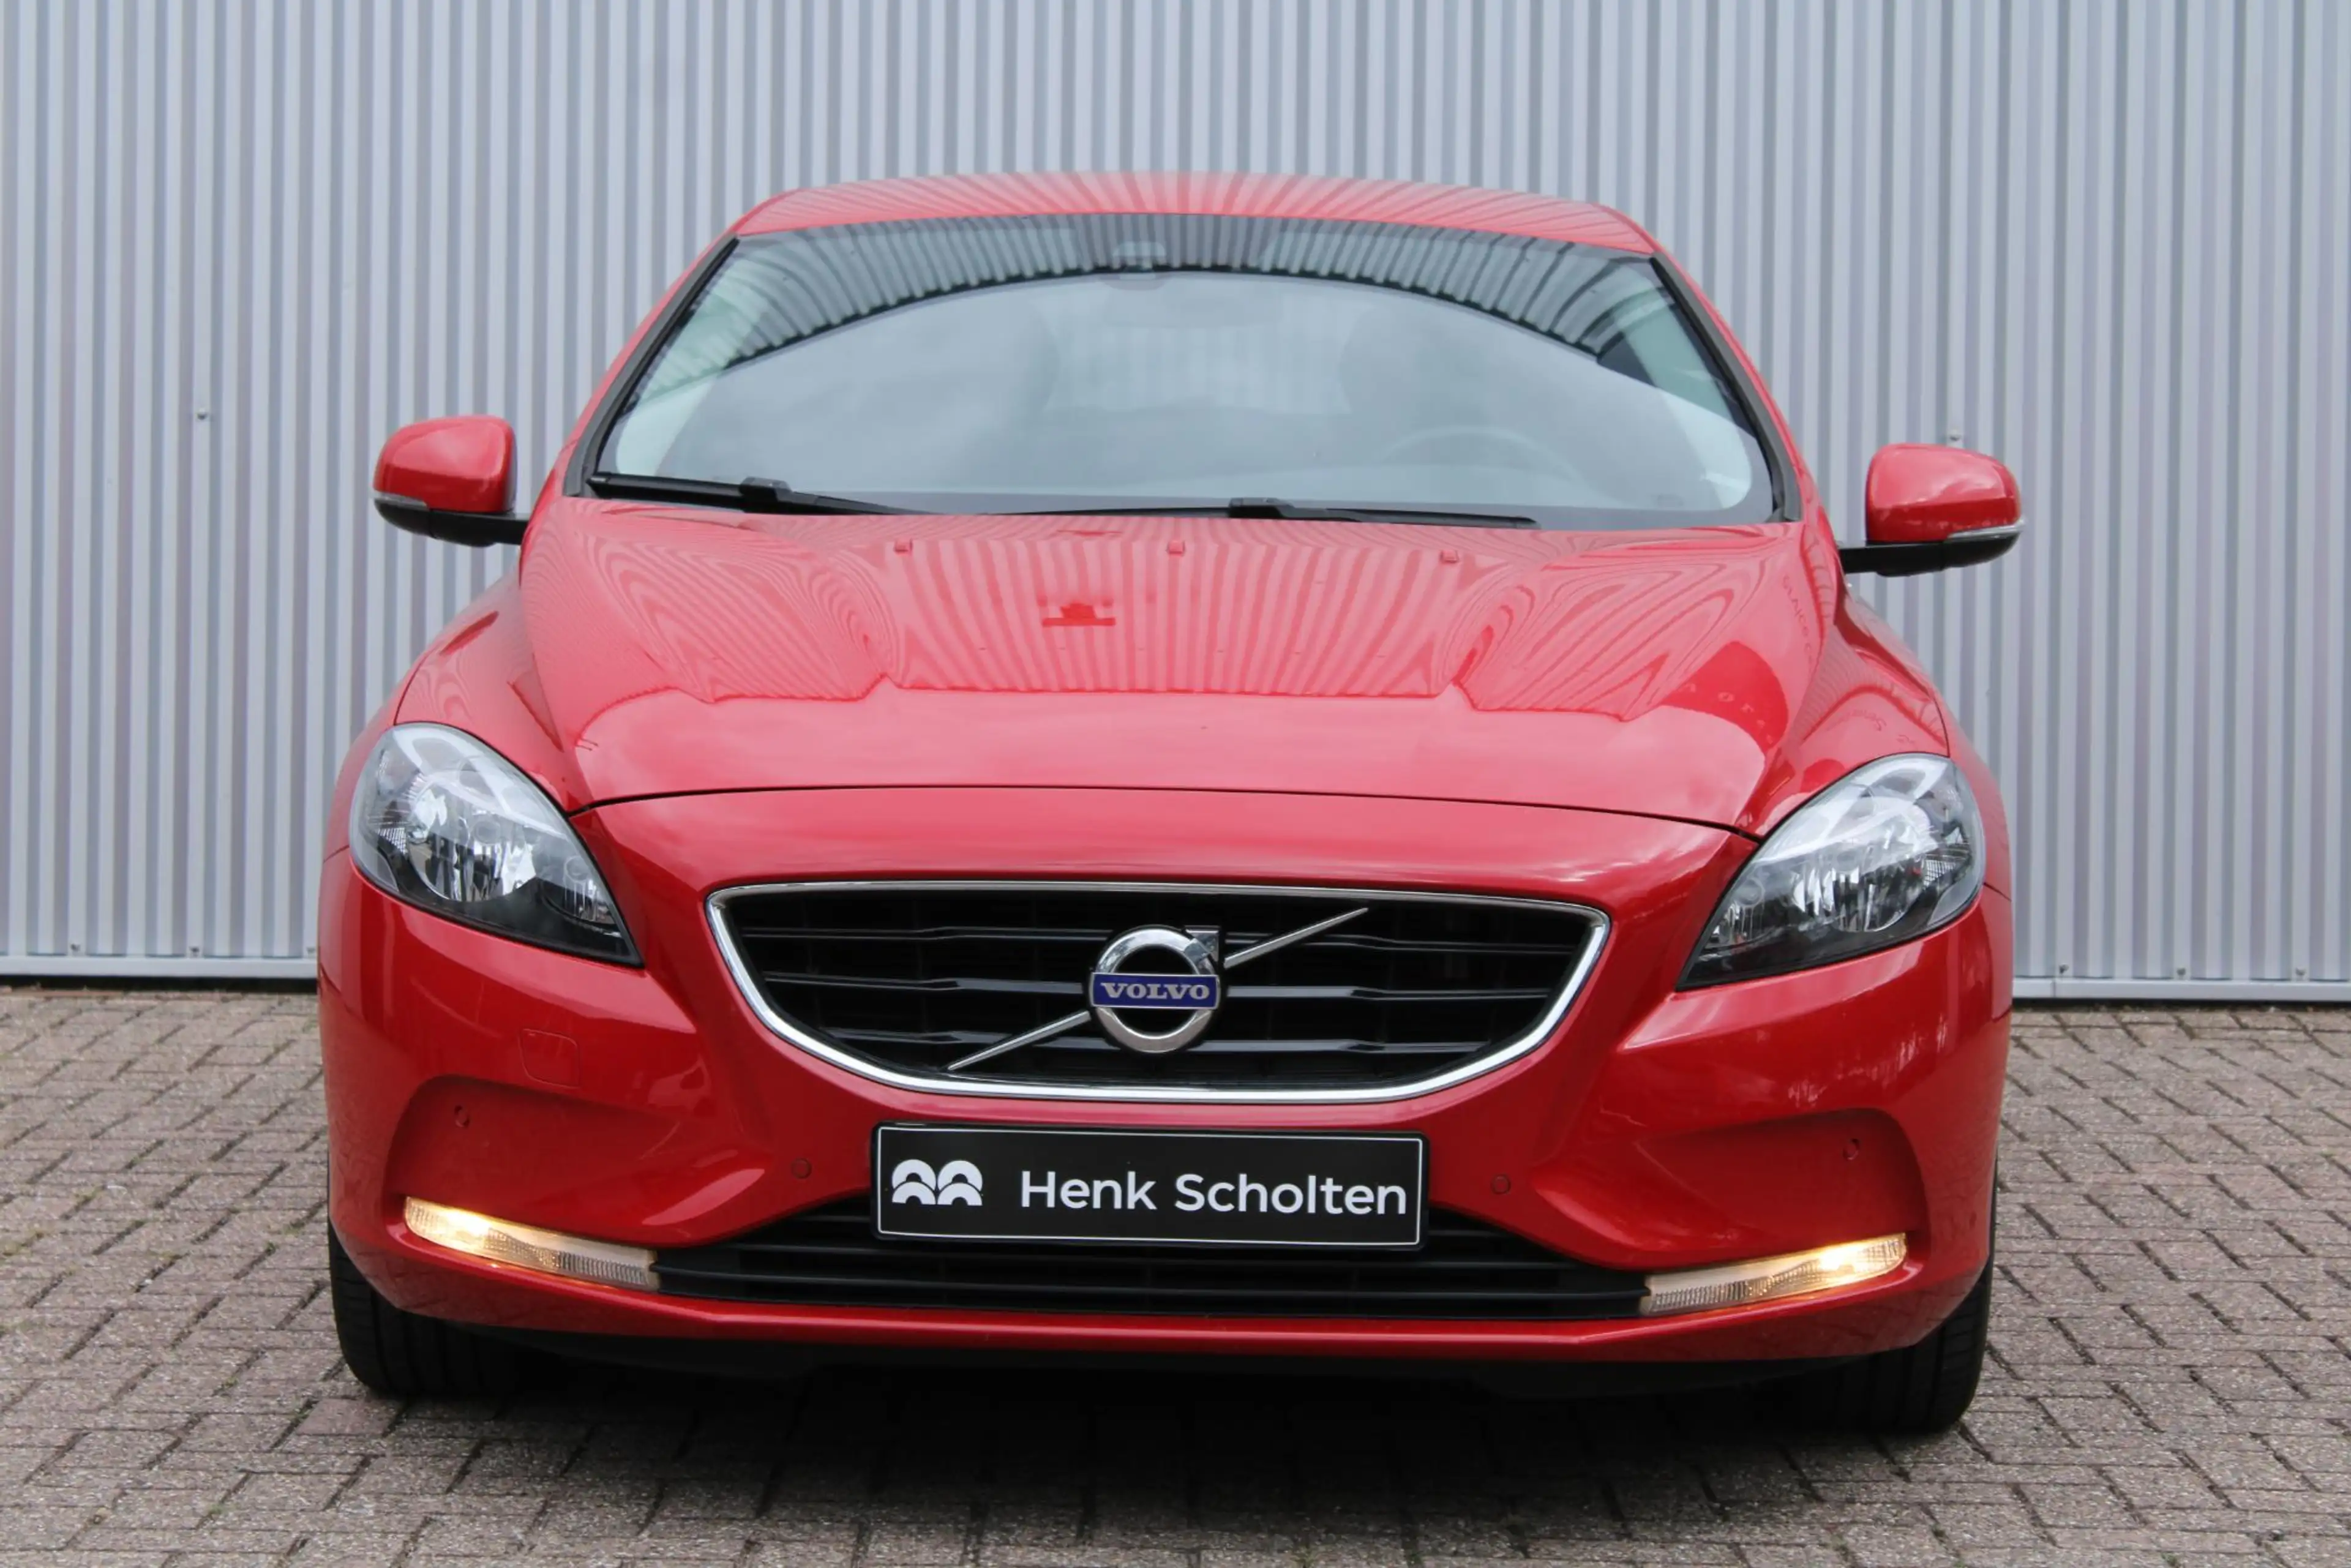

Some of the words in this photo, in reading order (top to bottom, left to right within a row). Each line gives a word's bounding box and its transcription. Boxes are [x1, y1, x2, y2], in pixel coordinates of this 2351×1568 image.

[1100, 982, 1209, 1000] VOLVO
[1021, 1170, 1157, 1210] Henk
[1175, 1172, 1407, 1215] Scholten
